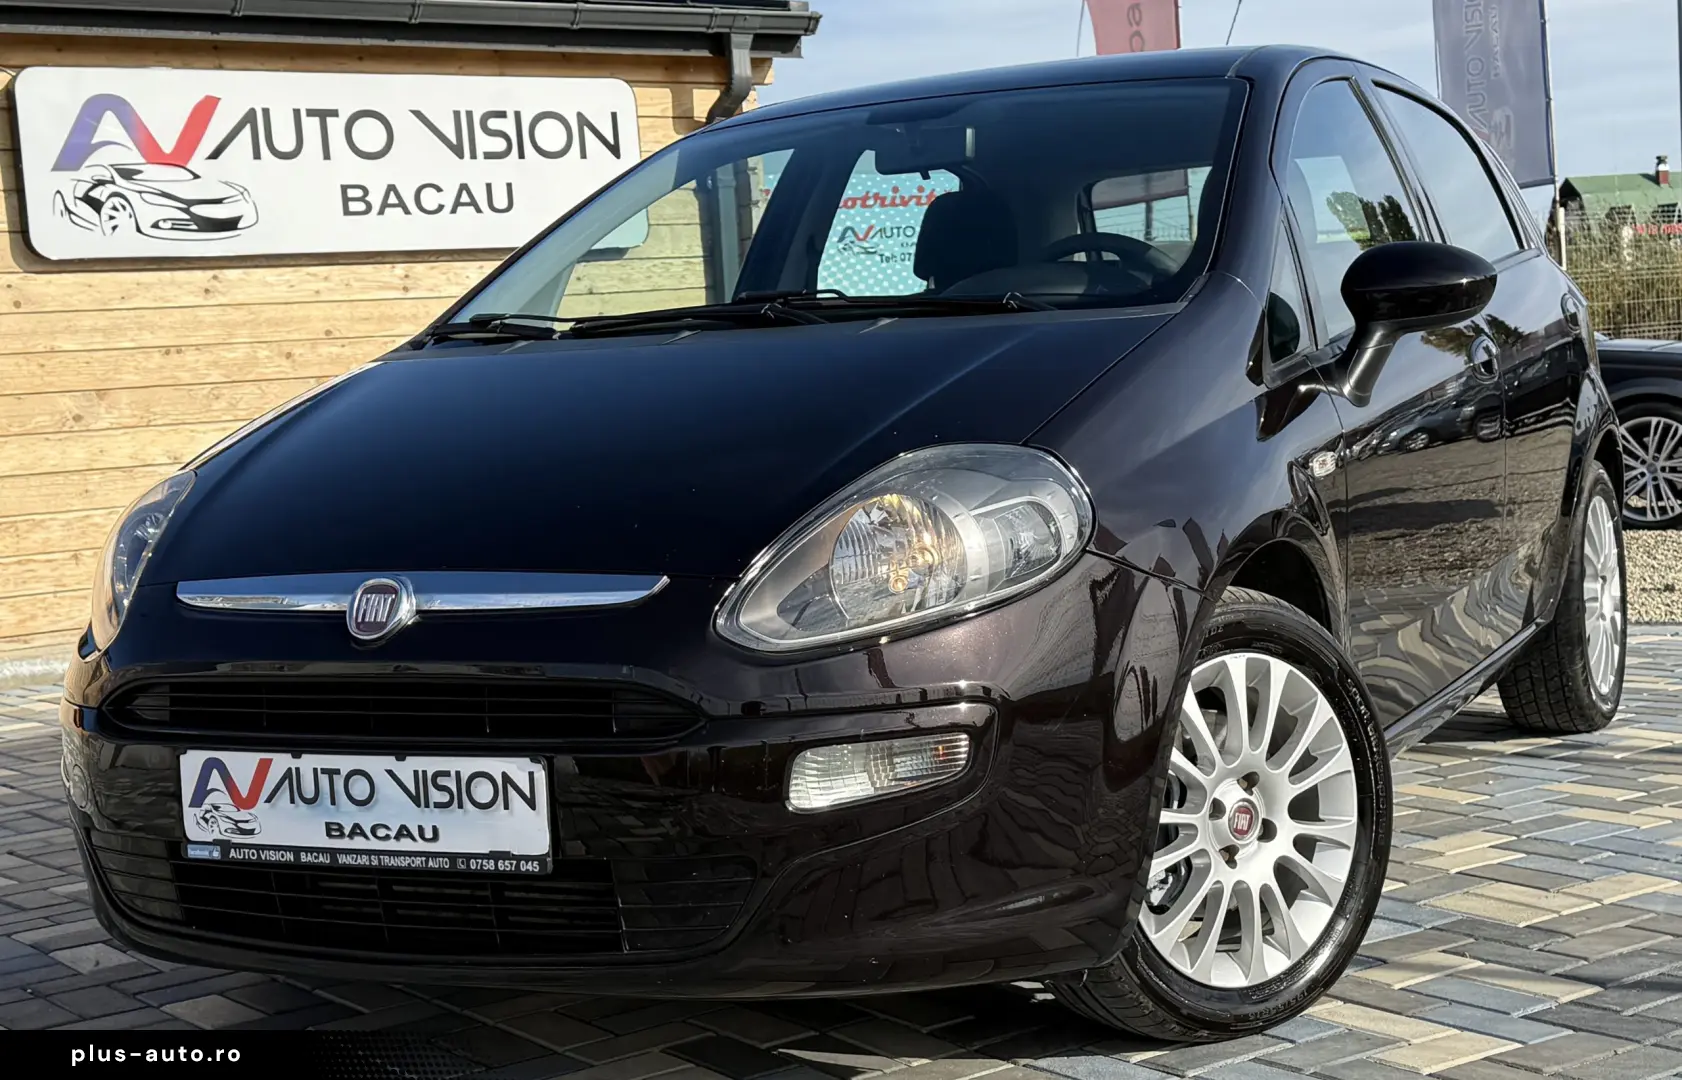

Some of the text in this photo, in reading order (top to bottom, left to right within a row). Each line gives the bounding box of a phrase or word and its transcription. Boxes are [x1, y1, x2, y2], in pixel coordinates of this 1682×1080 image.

[1464, 0, 1489, 134] AUTO VISI
[205, 107, 394, 161] AUTO
[409, 109, 621, 161] VISION
[340, 183, 515, 216] BACAU
[838, 185, 936, 209] otrivit
[871, 225, 916, 239] AUTO
[899, 253, 912, 262] 07
[358, 594, 396, 622] FIAT
[264, 766, 376, 806] AUTO
[384, 768, 537, 811] VISION
[324, 821, 440, 843] BACAU
[1233, 812, 1251, 831] FIAT
[229, 848, 540, 872] AUTO VISION BACAU VANZARI SI TRANSPORT AUTO 0758 657 045
